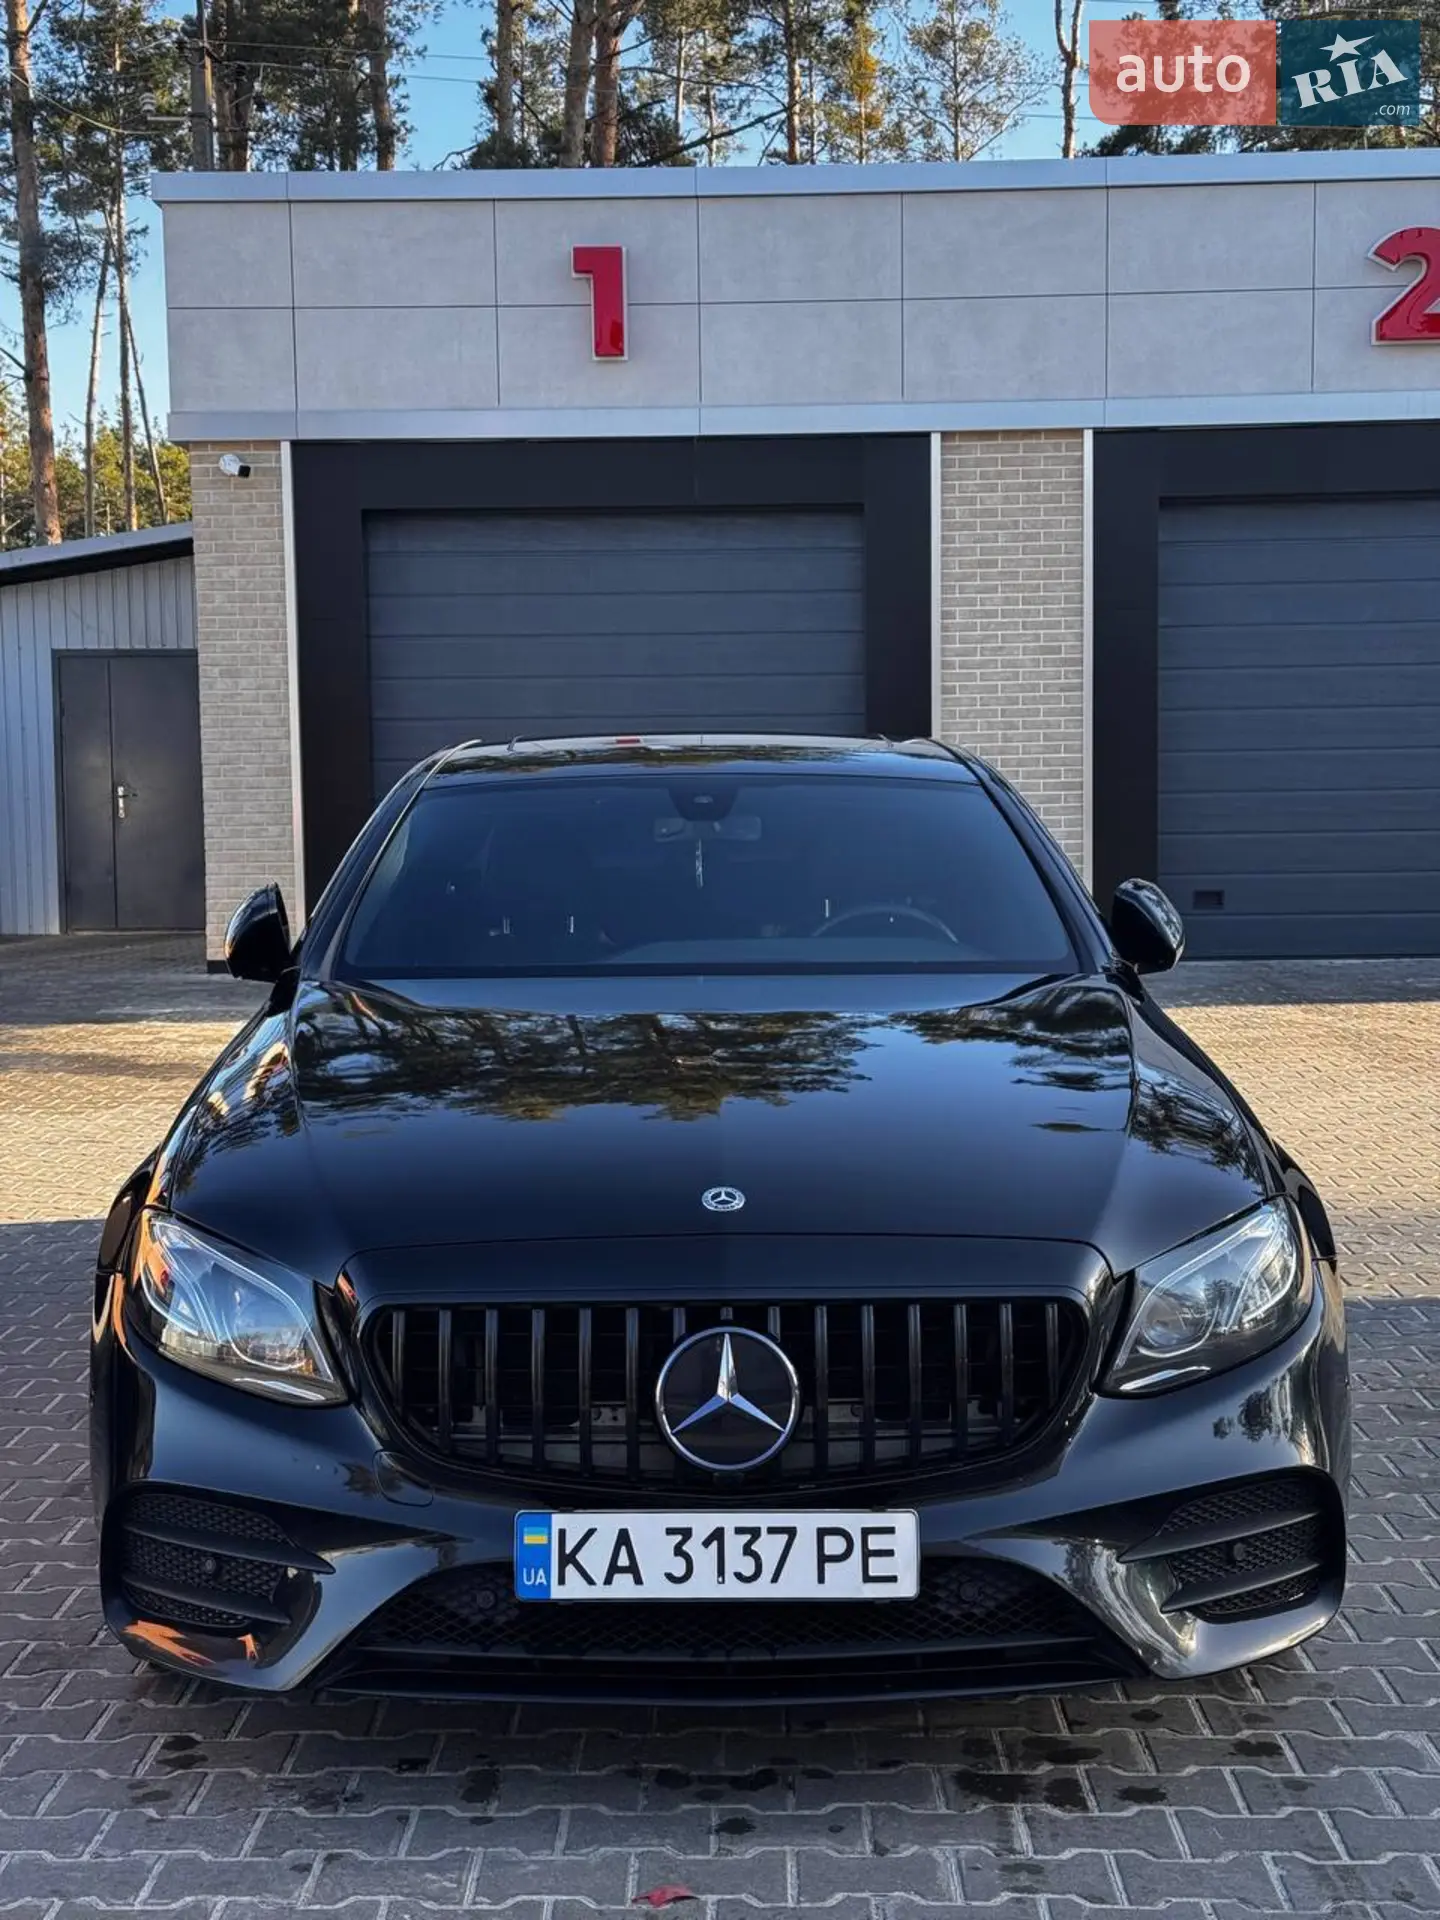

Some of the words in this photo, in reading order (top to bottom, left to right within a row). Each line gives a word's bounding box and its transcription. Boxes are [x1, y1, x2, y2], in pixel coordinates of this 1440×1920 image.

[571, 244, 628, 360] 1
[1368, 226, 1440, 346] 2
[523, 1567, 547, 1586] UA
[557, 1527, 644, 1586] KA
[664, 1526, 798, 1585] 3137
[816, 1526, 899, 1584] PE
